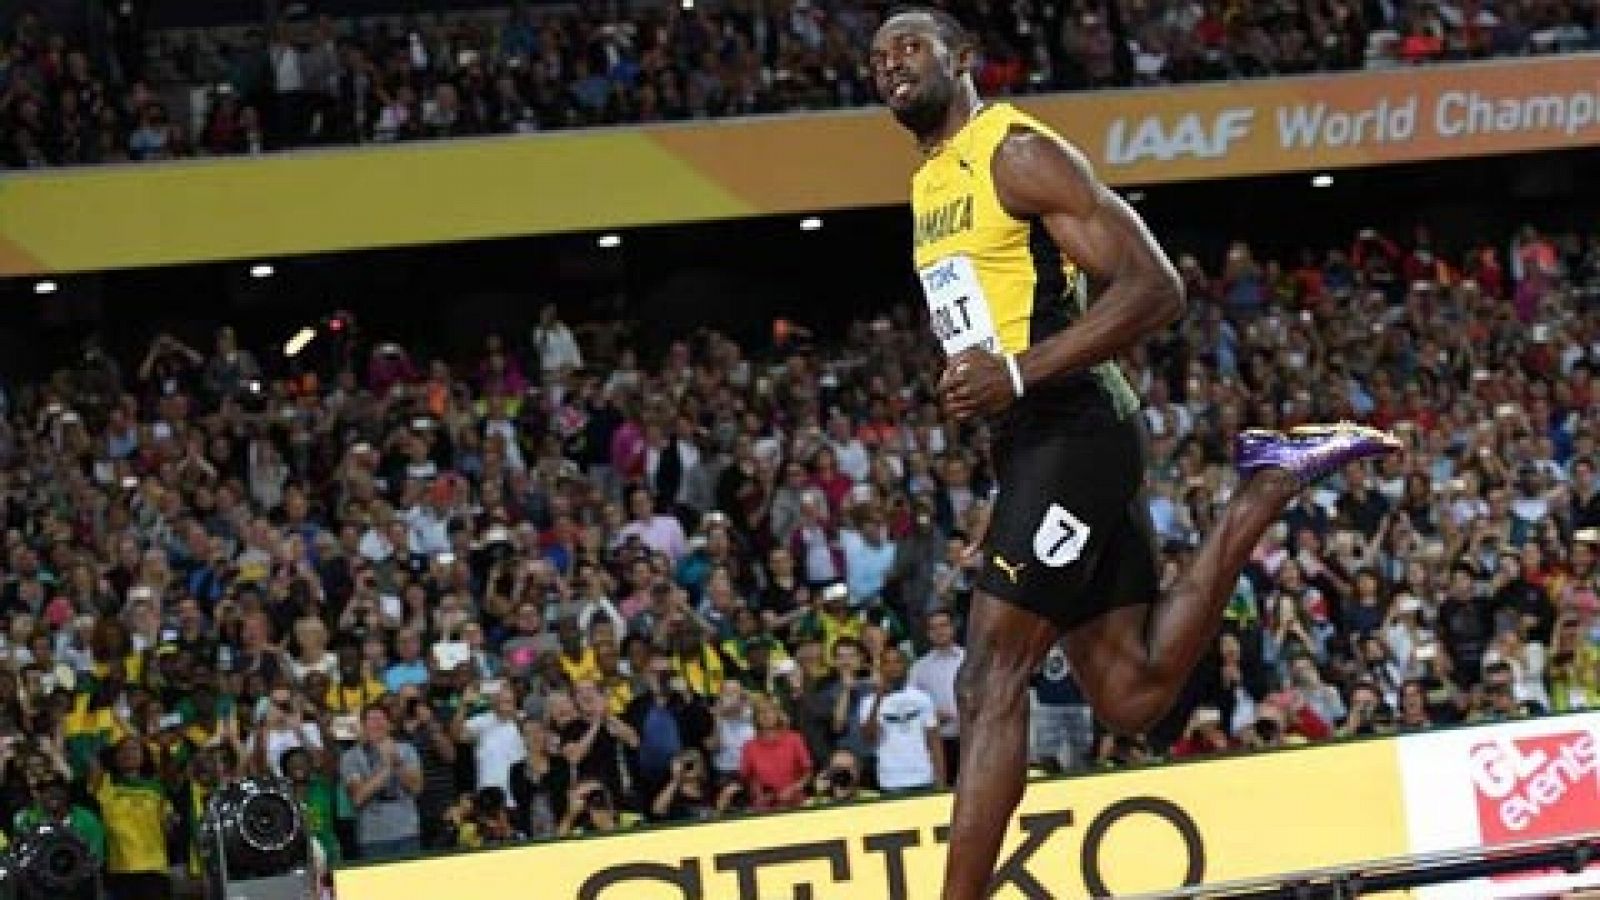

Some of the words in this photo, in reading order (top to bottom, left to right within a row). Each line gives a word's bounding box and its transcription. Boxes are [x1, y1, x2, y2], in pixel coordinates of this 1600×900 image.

[1106, 108, 1255, 164] IAAF
[1277, 97, 1419, 149] World
[930, 296, 972, 341] OLT
[1046, 519, 1078, 558] 7
[1500, 736, 1597, 831] events
